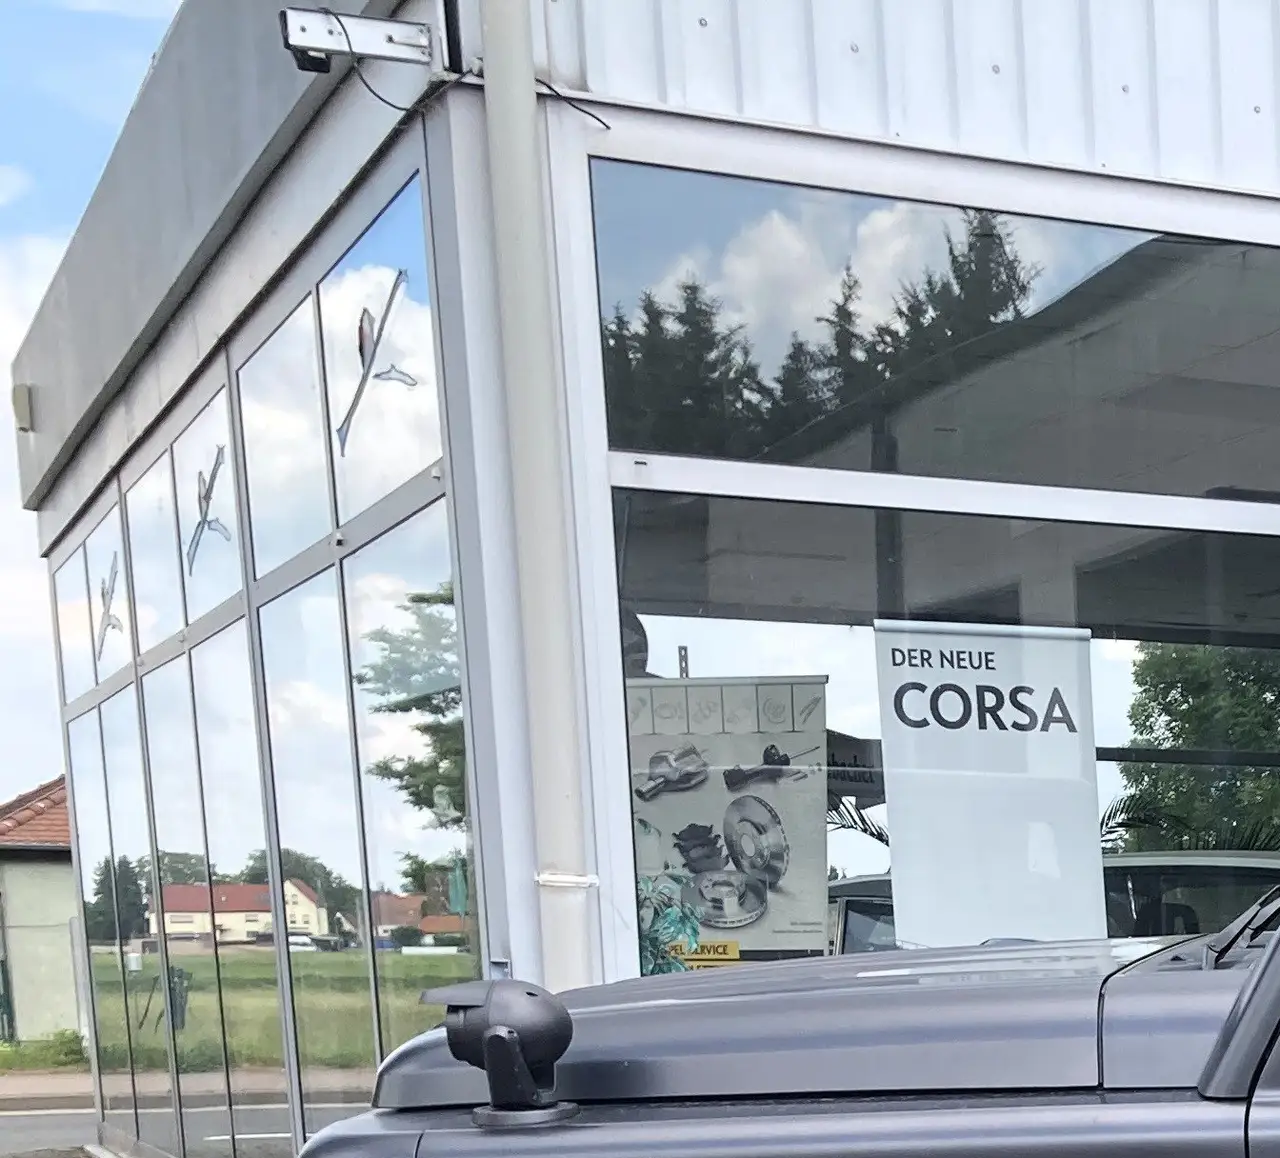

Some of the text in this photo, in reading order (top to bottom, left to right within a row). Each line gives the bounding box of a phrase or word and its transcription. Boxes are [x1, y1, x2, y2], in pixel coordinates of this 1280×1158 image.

[891, 648, 996, 670] DER NEUE
[893, 681, 1078, 733] CORSA
[691, 944, 729, 956] ERVICE
